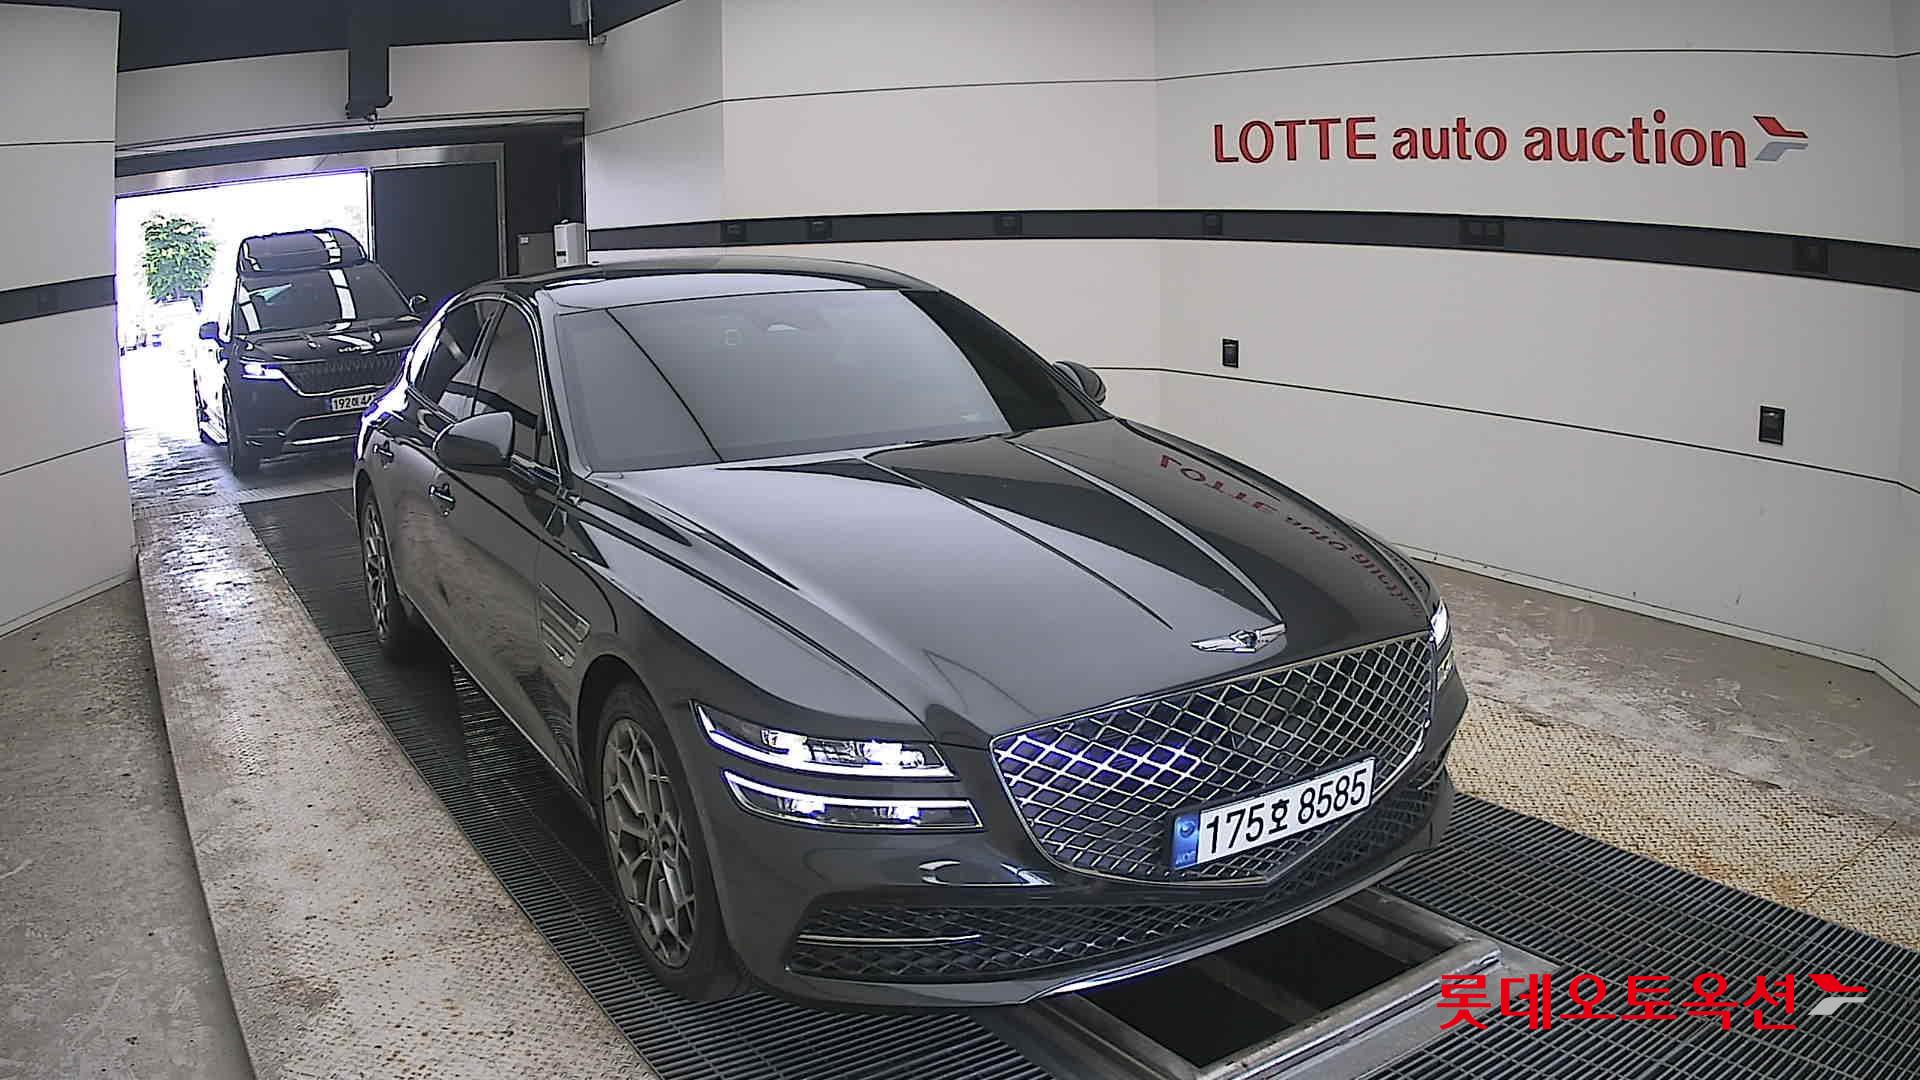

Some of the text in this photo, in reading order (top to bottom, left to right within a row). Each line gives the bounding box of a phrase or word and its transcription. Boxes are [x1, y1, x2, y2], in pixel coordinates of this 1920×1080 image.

[1213, 109, 1747, 168] LOTTE auto auction
[1206, 768, 1368, 854] 175호 8585
